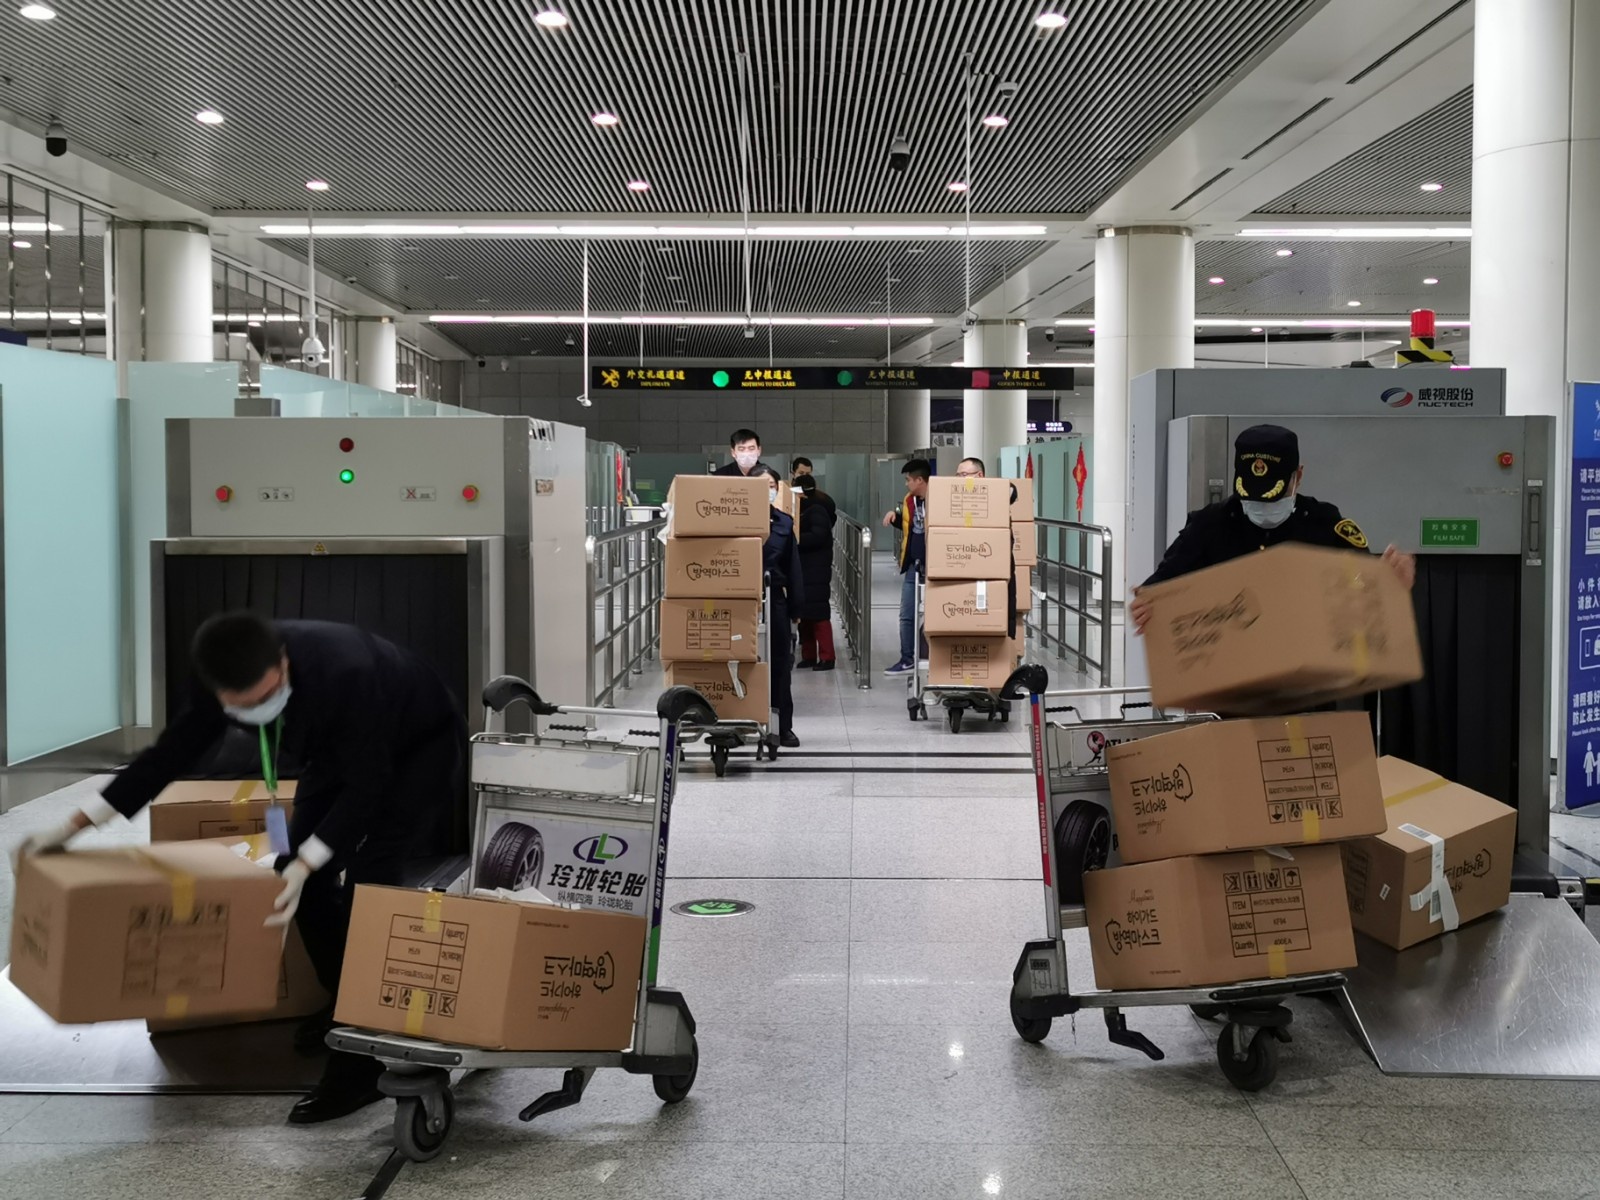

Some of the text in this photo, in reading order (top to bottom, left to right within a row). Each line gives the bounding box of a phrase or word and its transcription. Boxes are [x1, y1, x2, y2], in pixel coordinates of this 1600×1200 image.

[744, 369, 792, 380] 无申报通道
[868, 369, 916, 380] 无申报通道
[1003, 369, 1040, 380] 申报通道
[1418, 387, 1474, 400] 威视股份
[720, 497, 749, 505] 하이가드
[702, 506, 750, 516] 방역마스크
[692, 568, 740, 578] 방역마스크
[1130, 770, 1184, 796] 방역마스크
[1133, 798, 1168, 816] 하이가드
[548, 864, 648, 898] 玲珑轮胎
[598, 895, 634, 911] 玲珑轮胎
[1232, 901, 1246, 910] ITEM
[1126, 909, 1158, 924] 하이가드
[1273, 918, 1286, 926] KF94
[1113, 928, 1162, 950] 방역마스크
[1234, 940, 1254, 951] Quantity
[544, 956, 606, 978] 방역마스크
[540, 981, 582, 998] 하이가드
